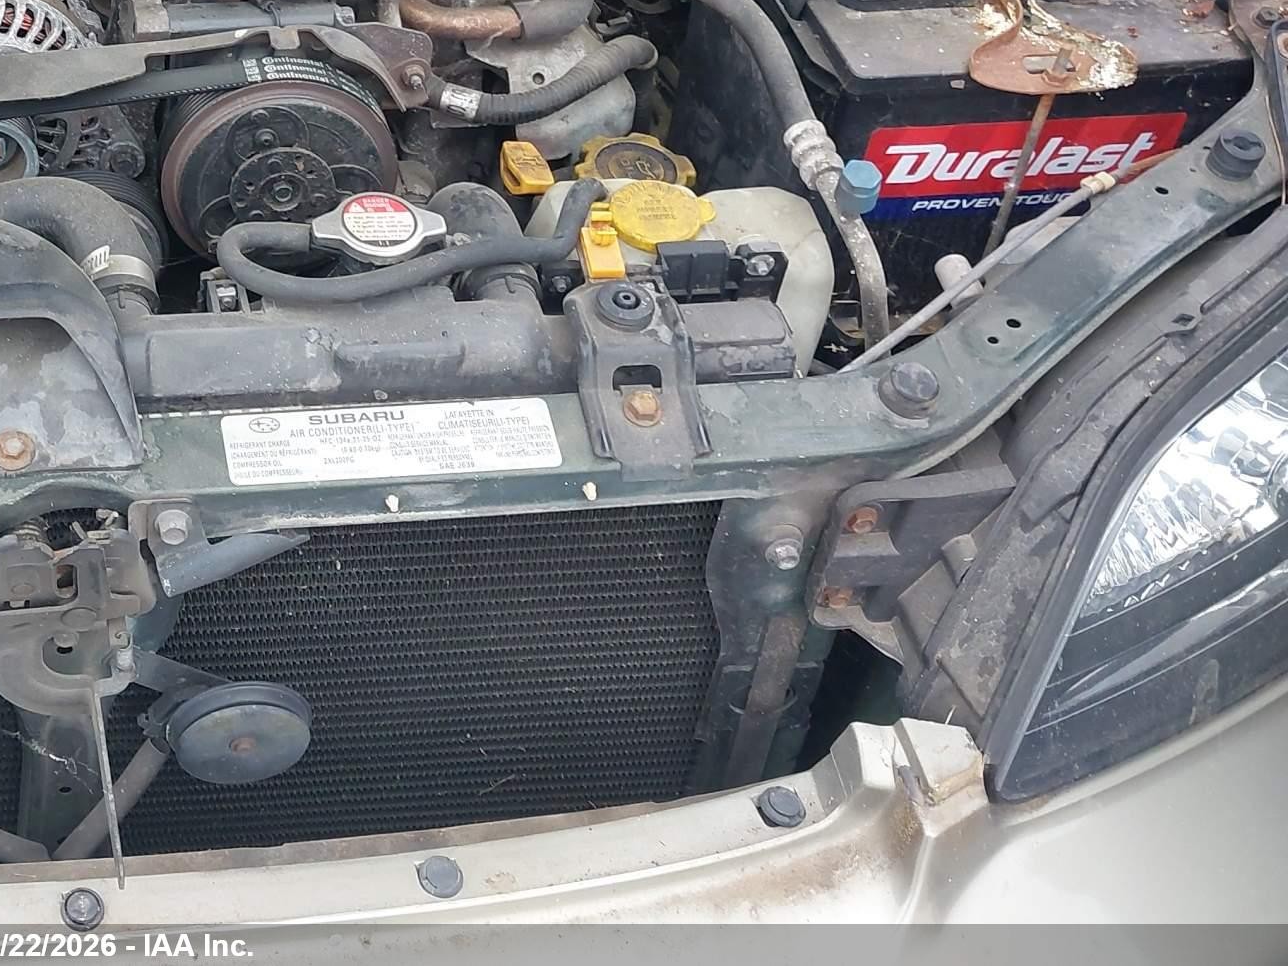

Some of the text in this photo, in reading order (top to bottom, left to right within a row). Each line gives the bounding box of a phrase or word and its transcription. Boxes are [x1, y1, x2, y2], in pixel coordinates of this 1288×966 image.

[885, 132, 1154, 184] Duralast
[912, 197, 1003, 212] PROVEN
[308, 410, 405, 425] SUBARU
[290, 428, 306, 438] AIR
